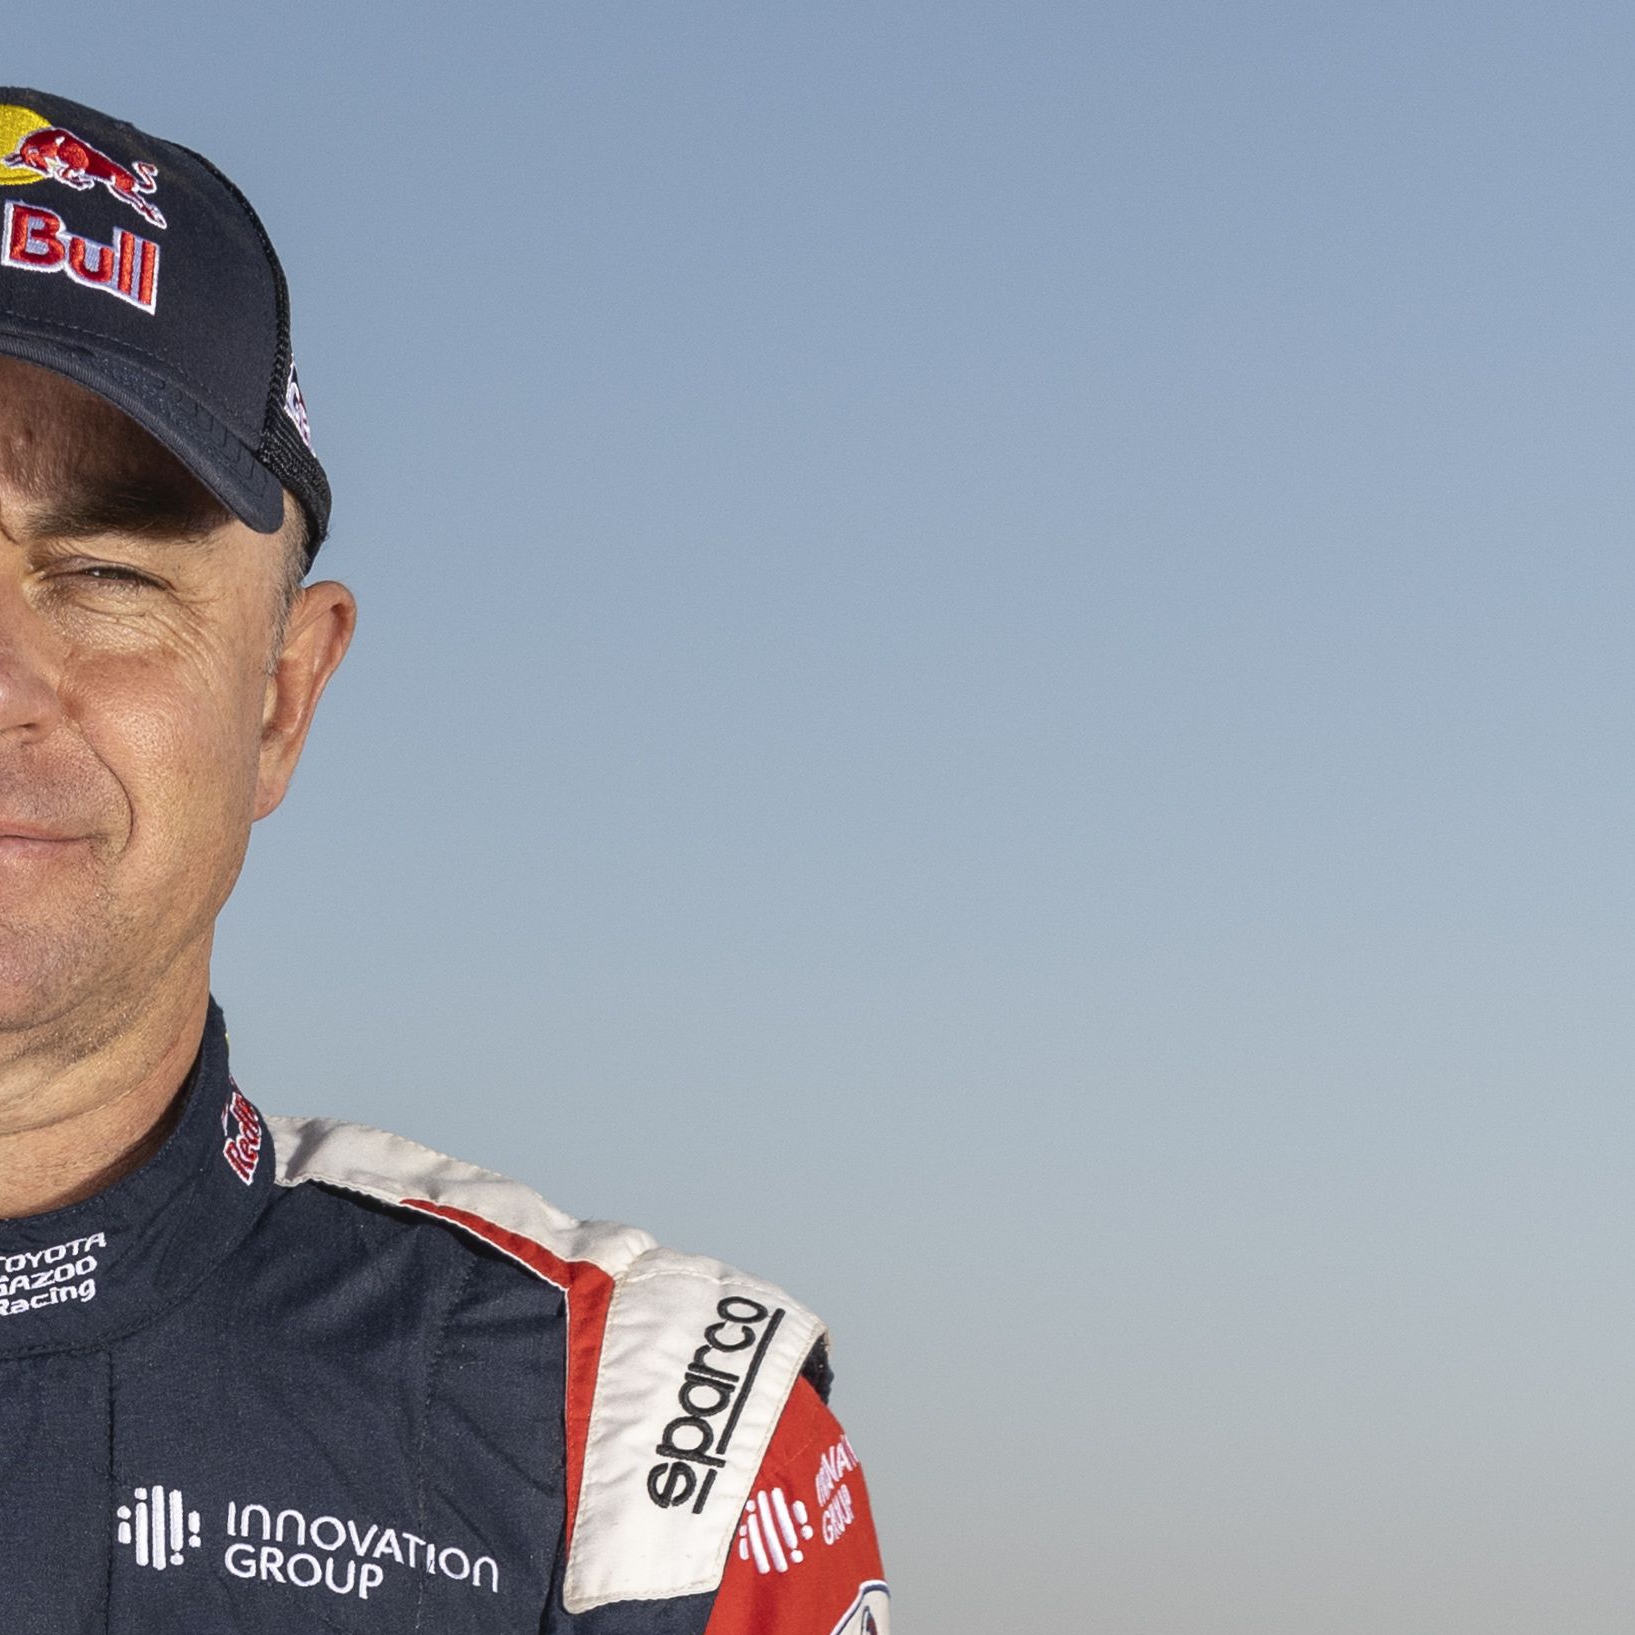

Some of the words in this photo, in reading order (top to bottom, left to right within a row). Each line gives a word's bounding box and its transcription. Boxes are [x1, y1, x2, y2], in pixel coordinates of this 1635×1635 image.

[1, 199, 160, 316] Bull
[647, 1296, 769, 1509] sparco
[224, 1543, 384, 1600] GROUP
